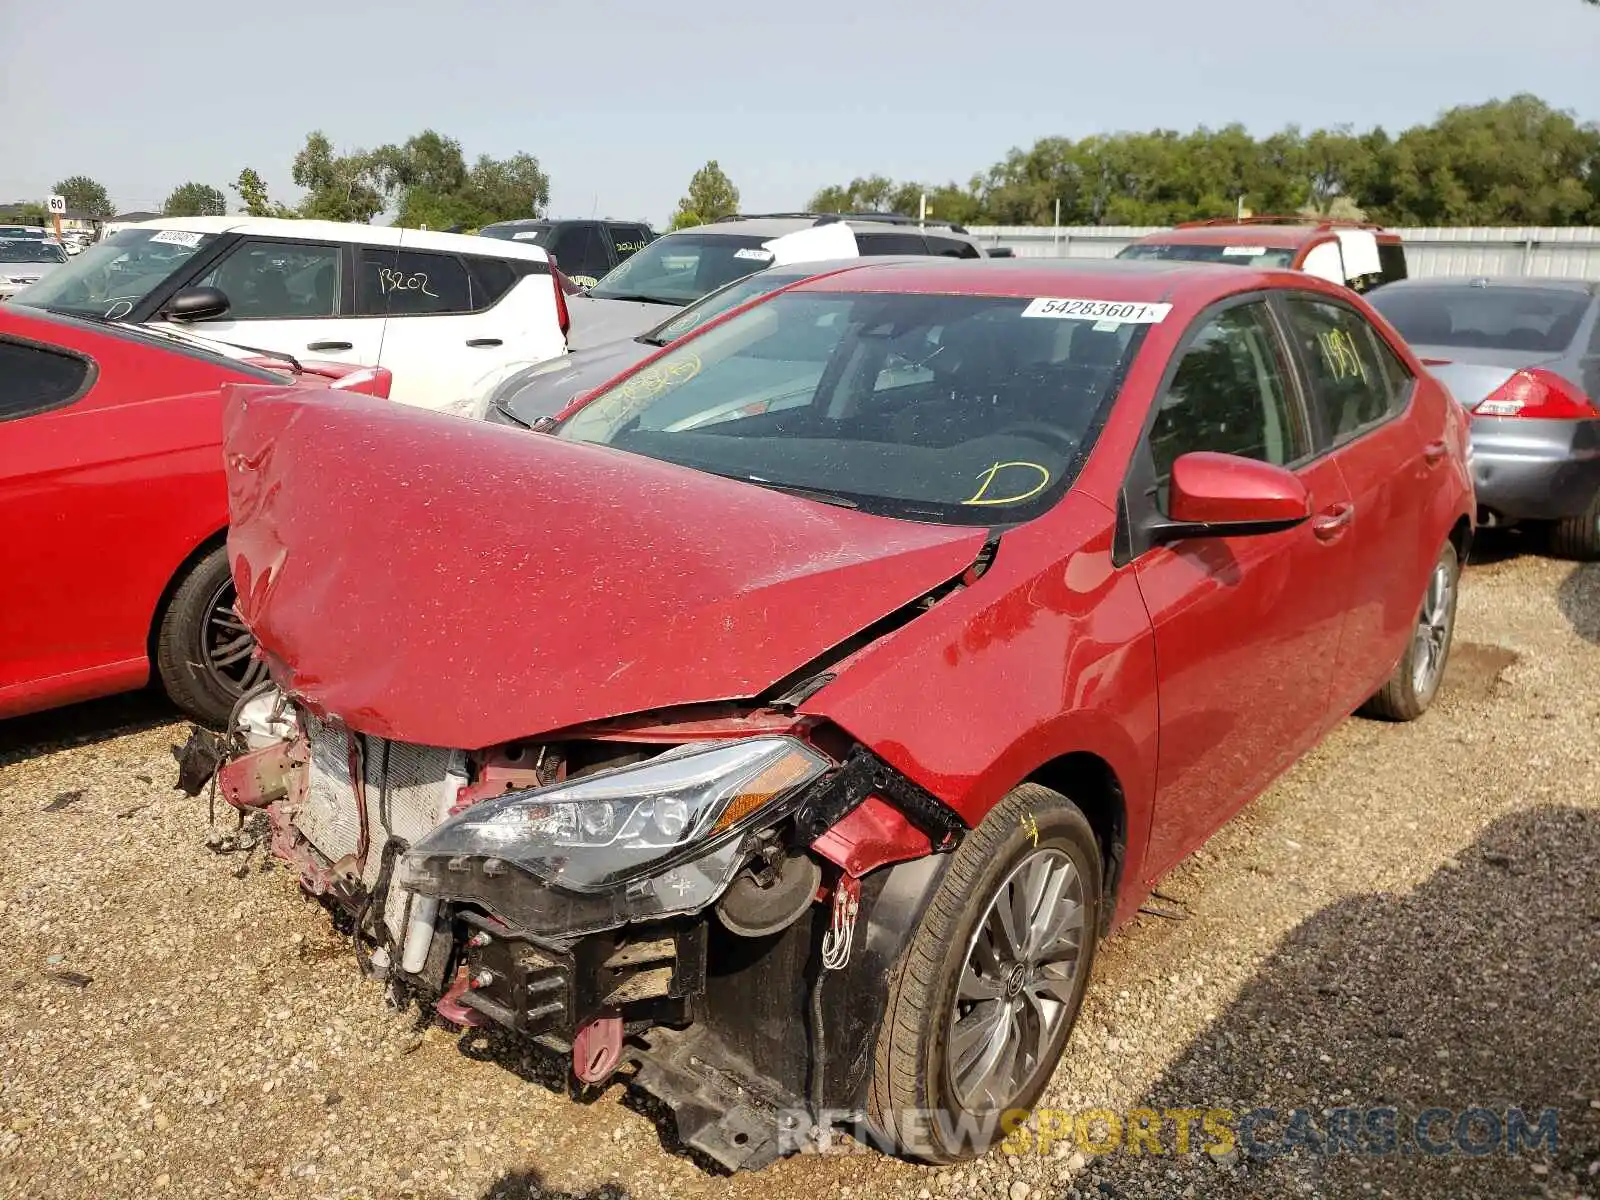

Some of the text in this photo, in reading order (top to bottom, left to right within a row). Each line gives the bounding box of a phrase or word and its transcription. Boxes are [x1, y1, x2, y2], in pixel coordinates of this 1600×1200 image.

[51, 198, 63, 209] 60
[1040, 299, 1148, 319] 54283601
[961, 461, 1050, 505] D
